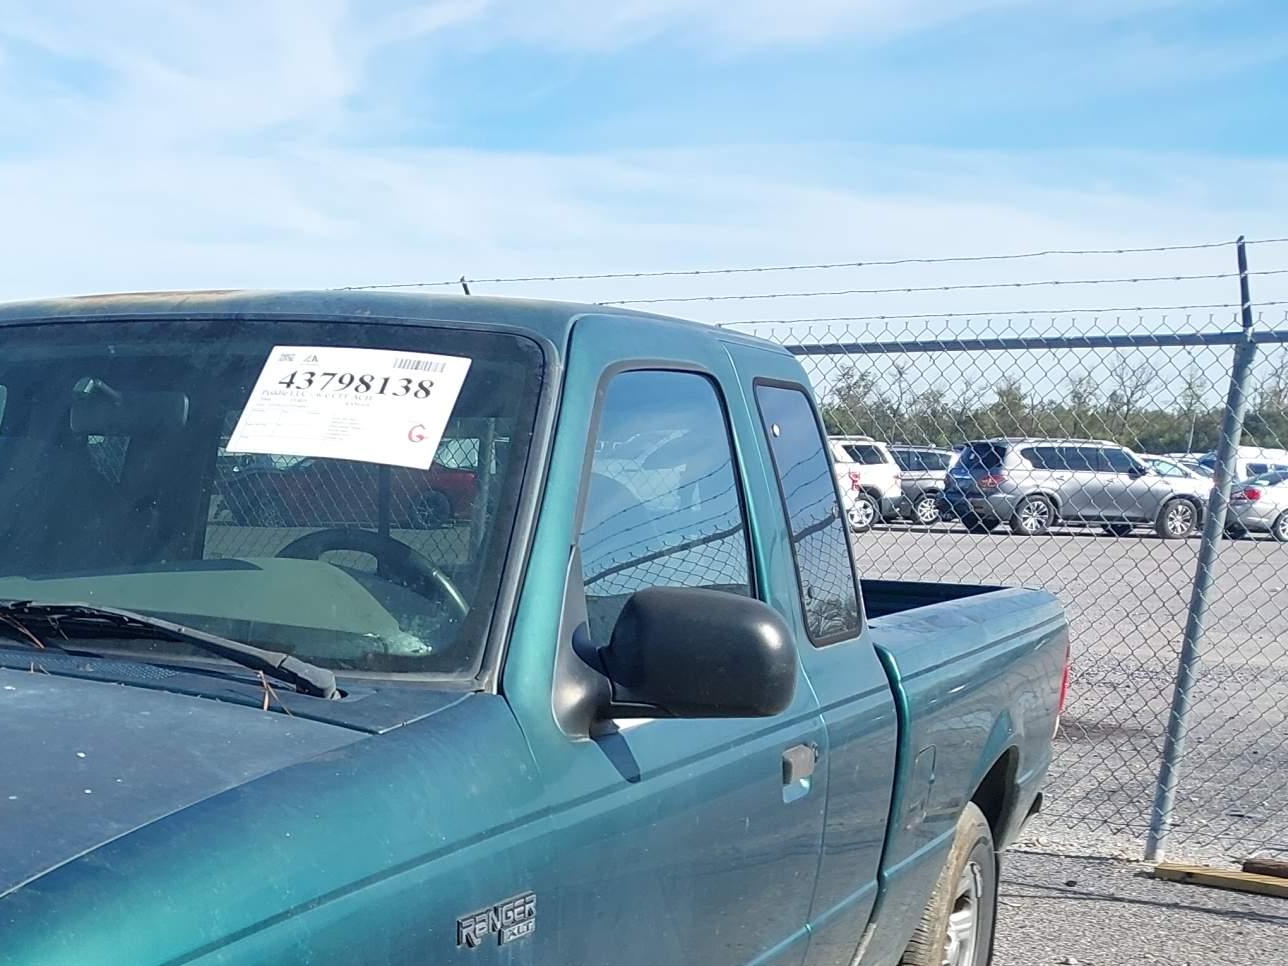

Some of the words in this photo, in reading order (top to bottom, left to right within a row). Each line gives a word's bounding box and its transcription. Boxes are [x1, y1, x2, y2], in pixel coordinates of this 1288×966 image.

[278, 370, 435, 400] 43798138
[408, 424, 427, 443] G
[456, 894, 536, 948] RANGER
